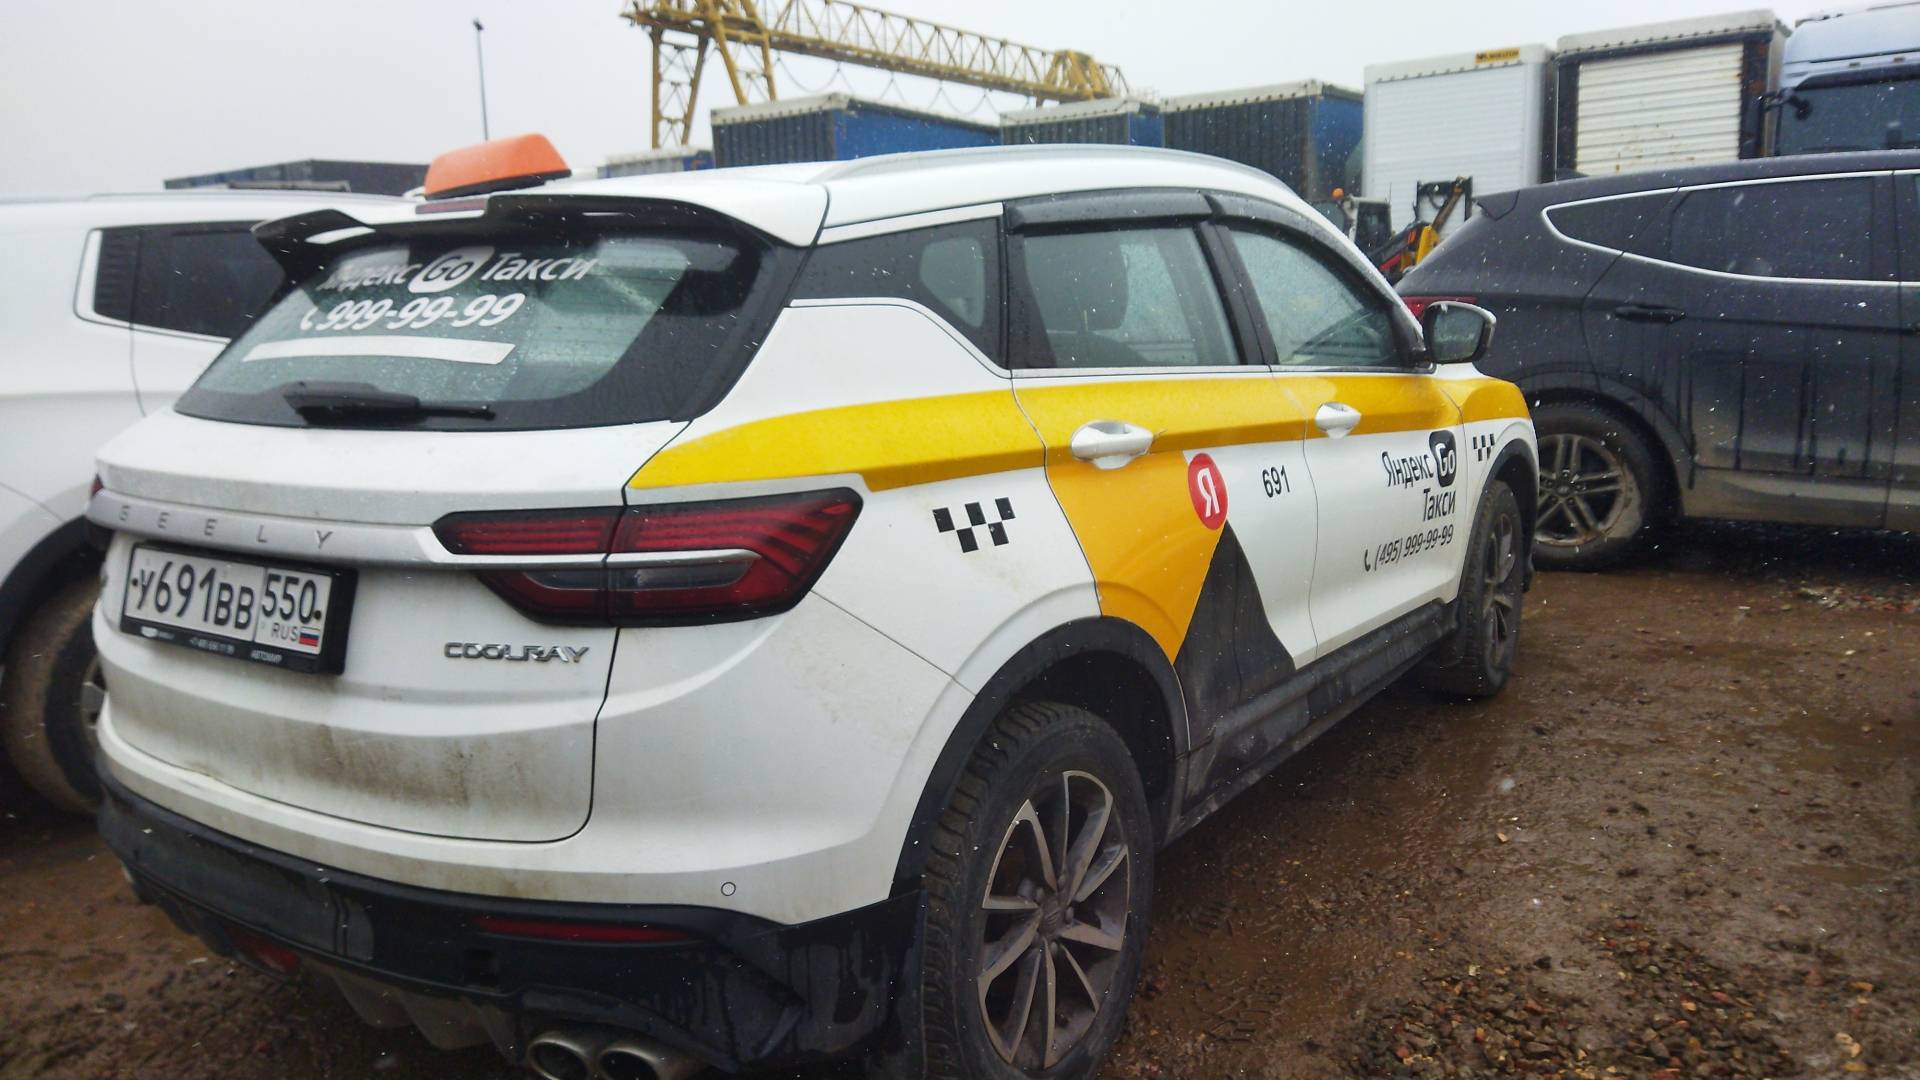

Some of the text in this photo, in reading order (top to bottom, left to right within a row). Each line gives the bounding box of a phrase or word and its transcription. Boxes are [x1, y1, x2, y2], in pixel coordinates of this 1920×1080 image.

[480, 251, 601, 281] Такси
[315, 292, 526, 331] 999-99-99
[1261, 465, 1291, 499] 691
[1381, 451, 1435, 489] Яндекс
[1197, 466, 1220, 519] Я
[1422, 487, 1457, 522] Такси
[118, 504, 333, 550] GEELY
[1374, 523, 1454, 572] (495) 999-99-99
[261, 573, 317, 625] 550
[270, 621, 299, 643] RUS
[443, 641, 591, 663] COOLRAY
